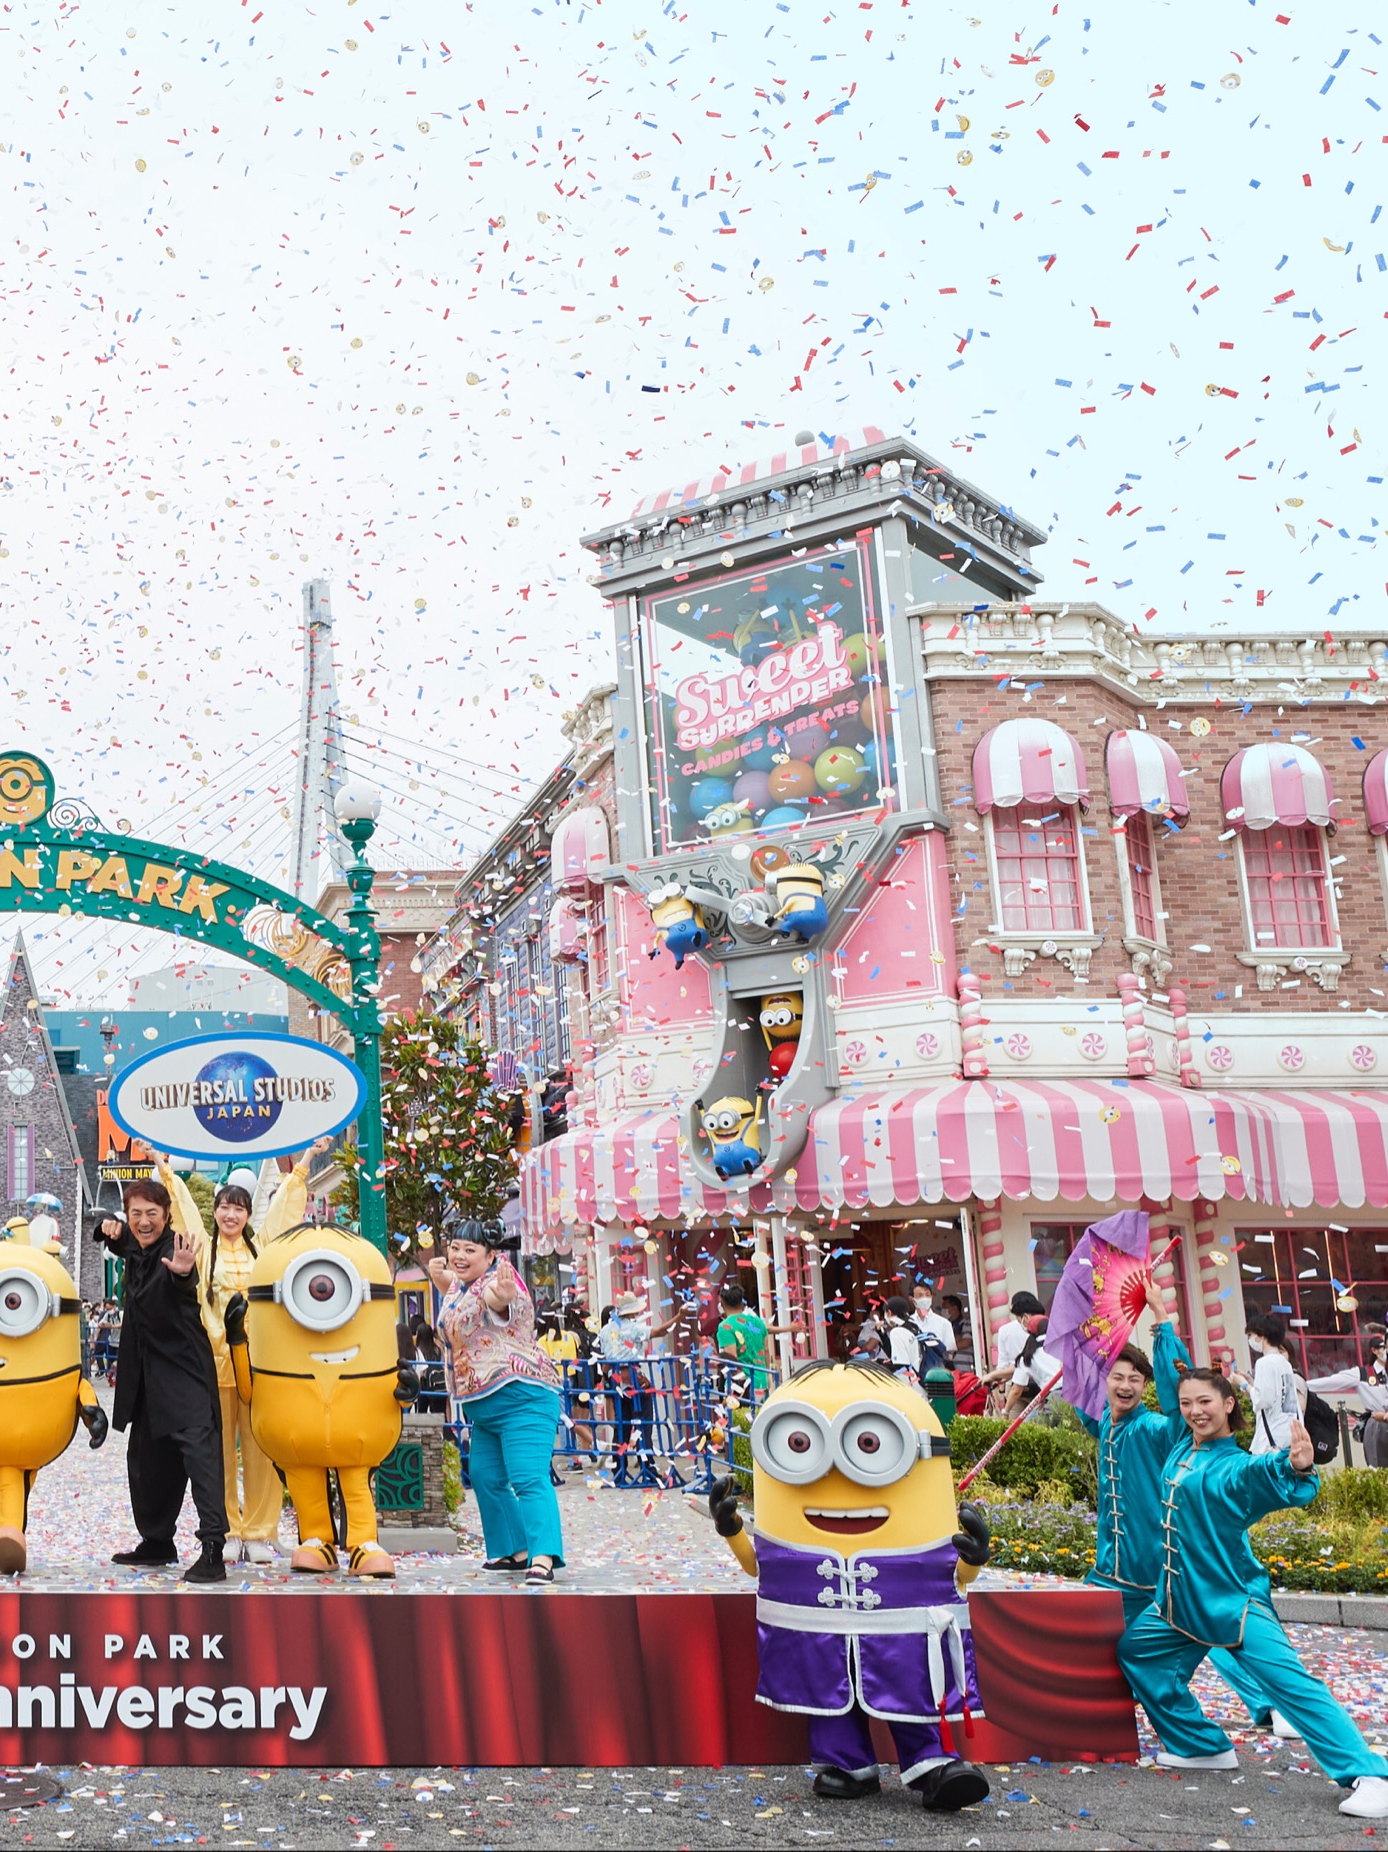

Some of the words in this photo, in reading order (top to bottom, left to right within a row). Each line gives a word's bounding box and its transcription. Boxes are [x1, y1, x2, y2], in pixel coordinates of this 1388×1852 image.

[677, 622, 849, 728] Sweet
[679, 666, 854, 749] SURRENDER
[681, 736, 764, 776] CANDIES
[783, 700, 860, 737] TREATS
[55, 850, 231, 924] PARK
[140, 1079, 248, 1112] UNIVERSAL
[253, 1076, 337, 1104] STUDIOS
[206, 1104, 272, 1121] JAPAN
[135, 1168, 153, 1179] MAY
[103, 1633, 225, 1659] PARK
